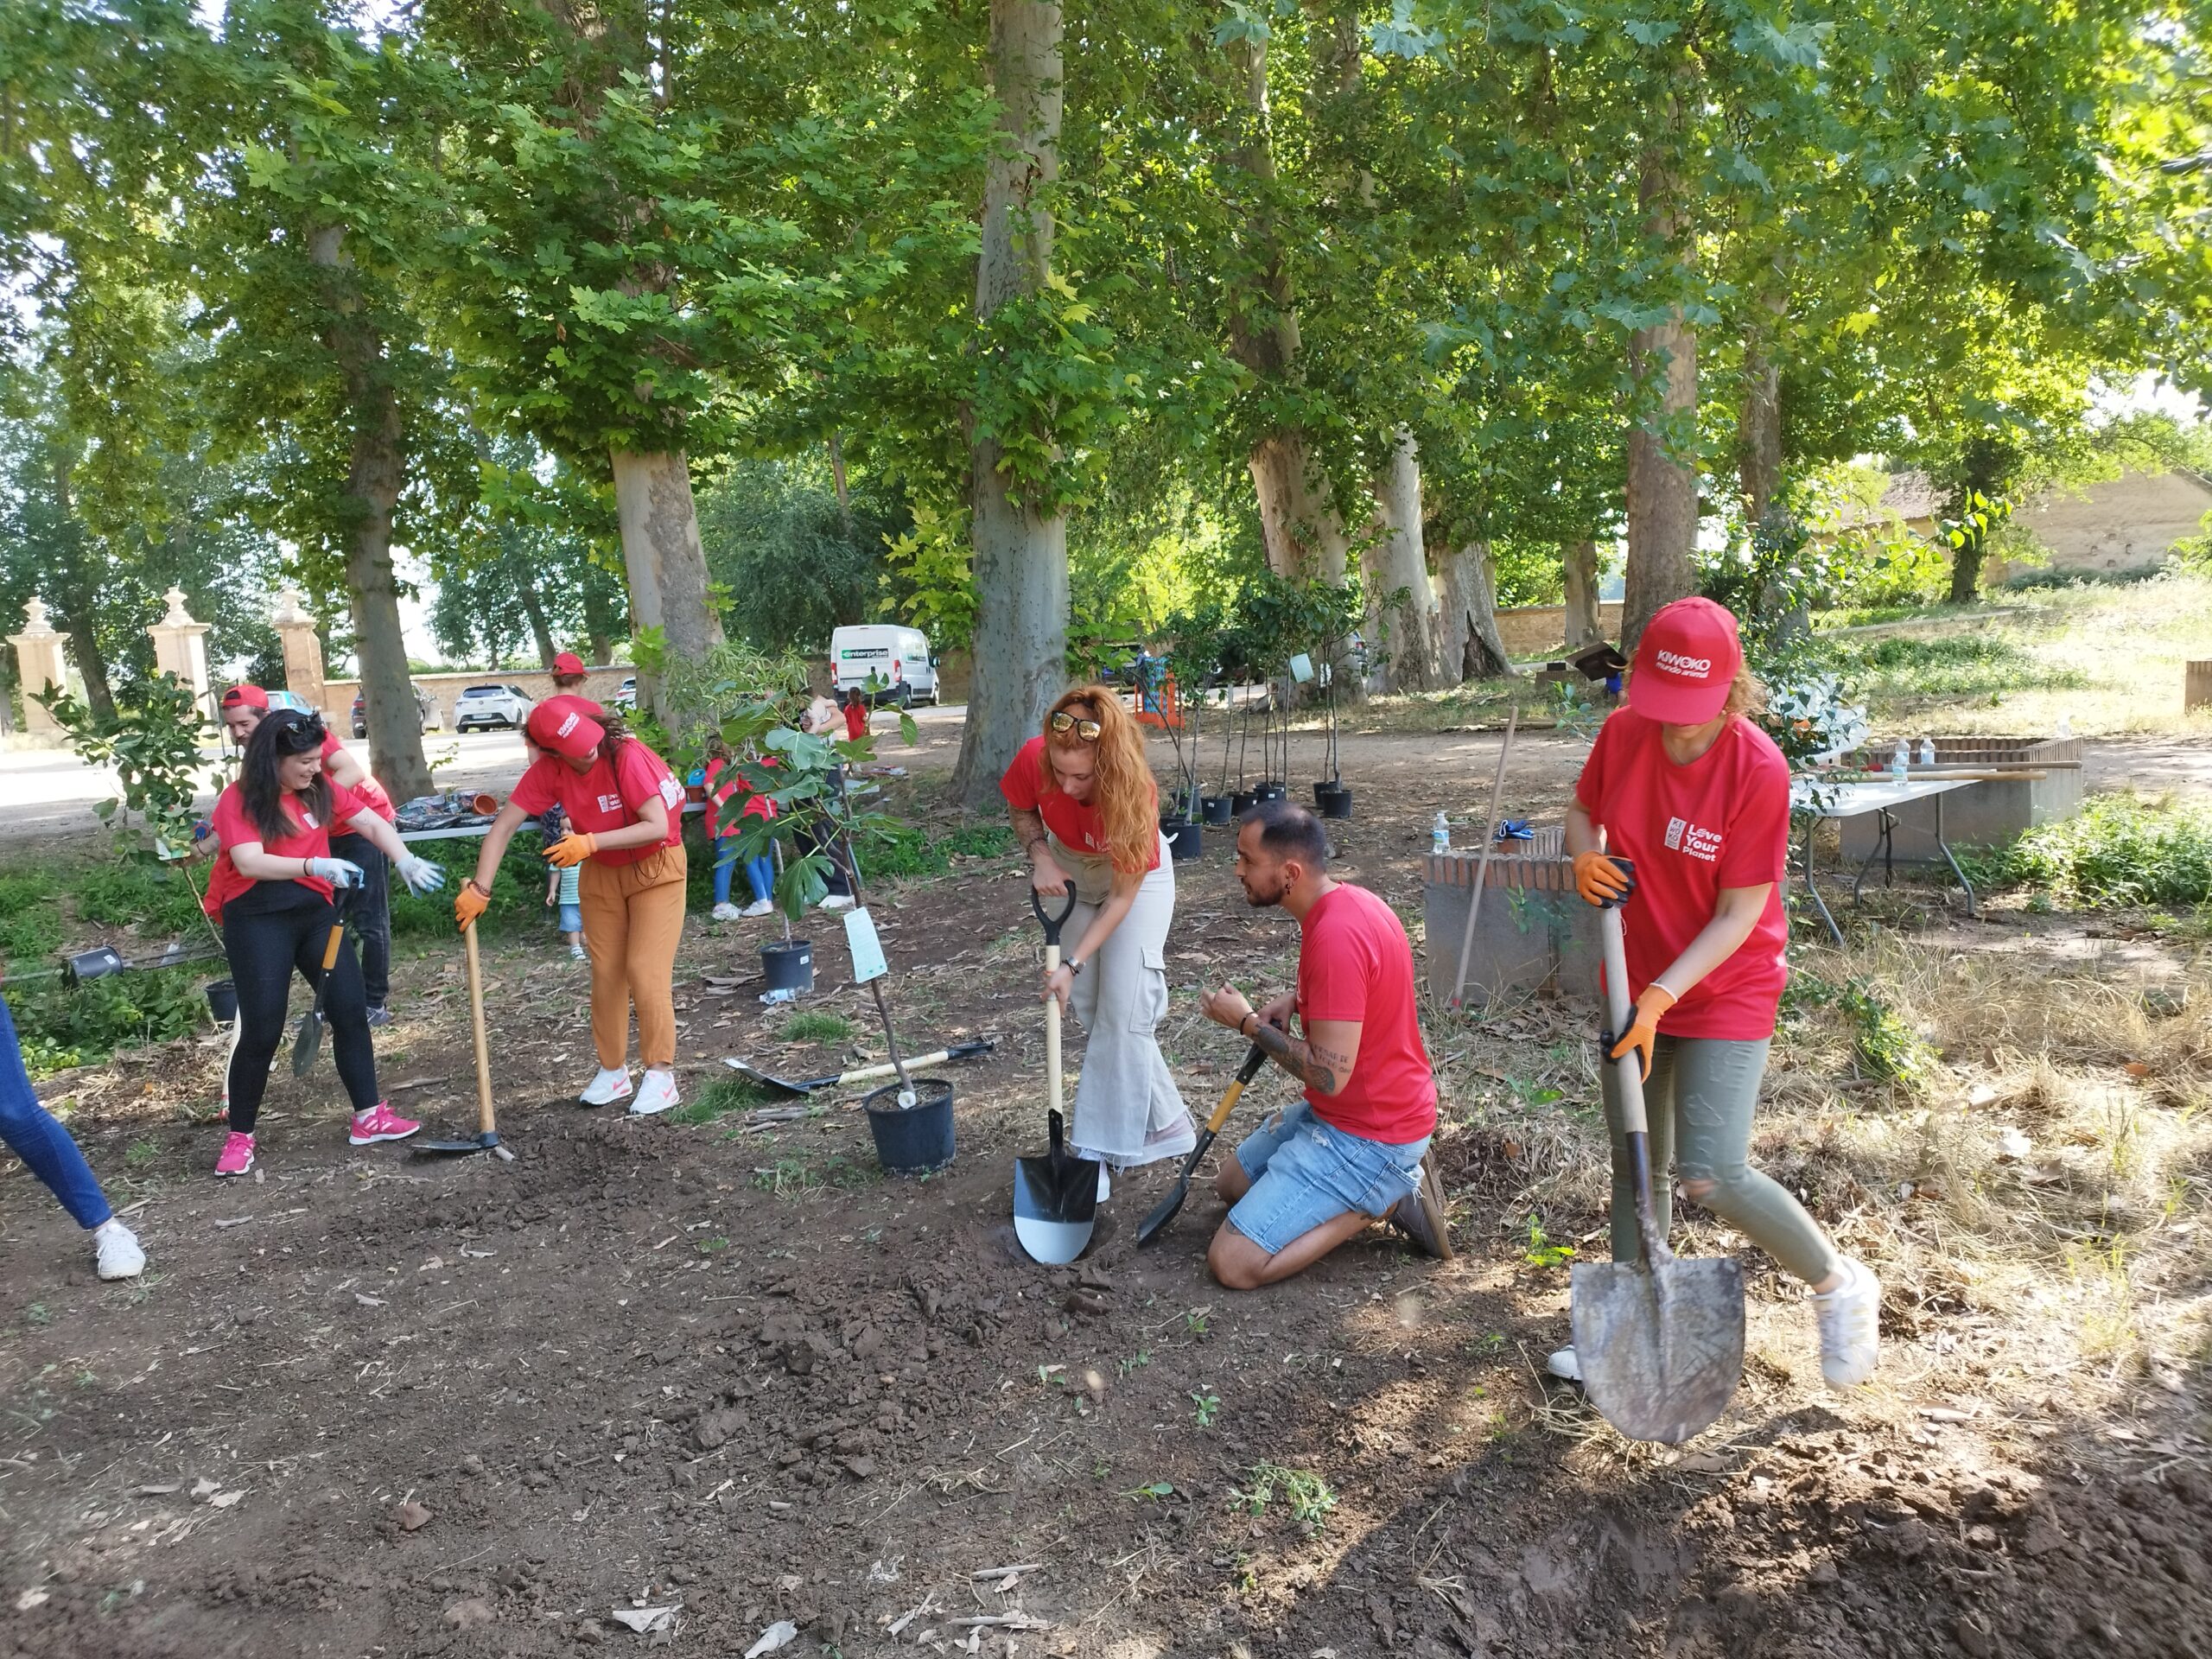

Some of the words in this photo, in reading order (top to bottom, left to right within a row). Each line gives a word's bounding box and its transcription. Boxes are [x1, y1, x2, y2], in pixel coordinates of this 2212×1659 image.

[842, 649, 888, 658] enterprise
[1657, 650, 1712, 671] KIWOKO
[1688, 823, 1722, 842] Love
[1686, 834, 1719, 853] Your
[1682, 846, 1716, 861] Planet
